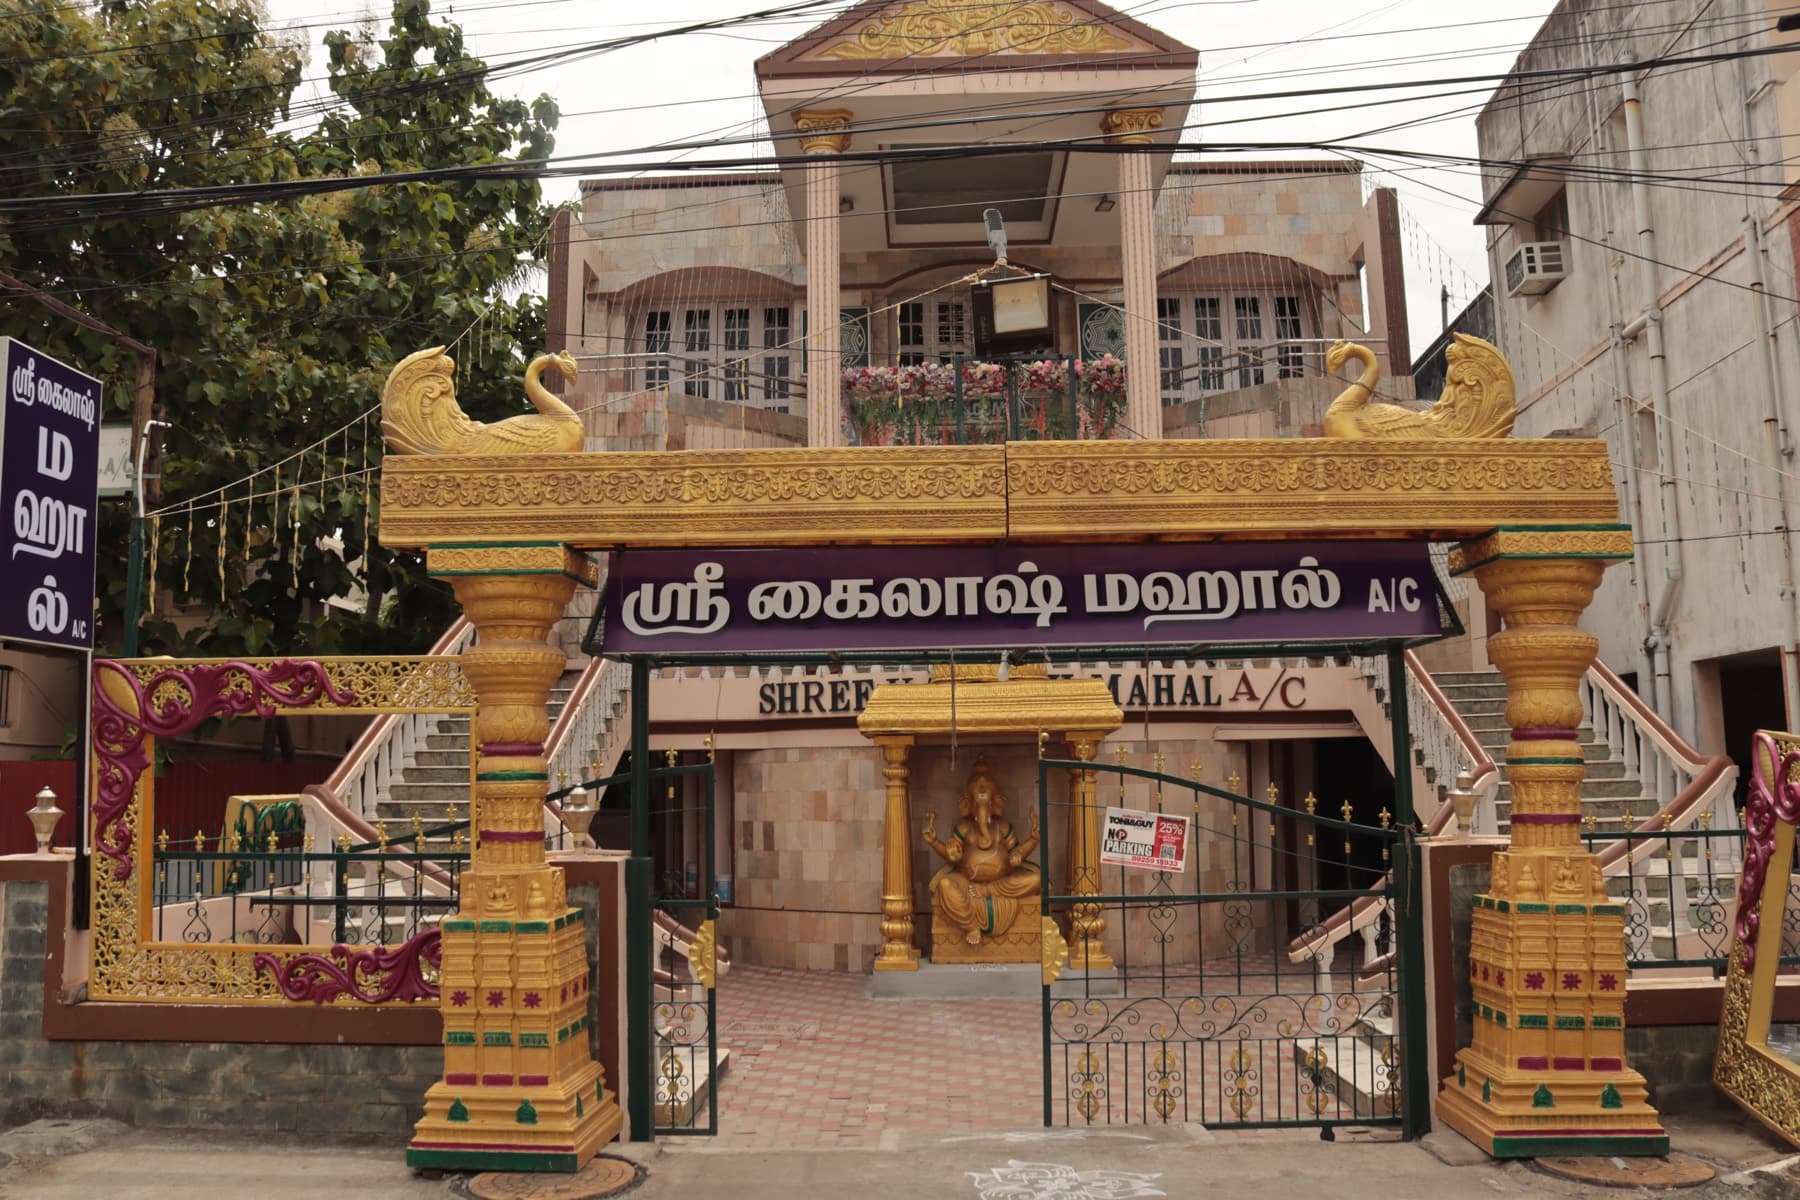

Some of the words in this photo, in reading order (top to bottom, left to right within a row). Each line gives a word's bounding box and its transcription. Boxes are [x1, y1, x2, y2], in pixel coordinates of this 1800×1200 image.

[38, 377, 95, 432] கைலாஷ்
[747, 561, 1067, 627] கைலாஷ்
[1083, 556, 1341, 631] மஹால்
[1367, 577, 1421, 614] A/C
[72, 619, 87, 640] A/C
[1228, 668, 1307, 711] A/C
[1159, 822, 1184, 836] 25%
[1105, 839, 1153, 857] PARKING
